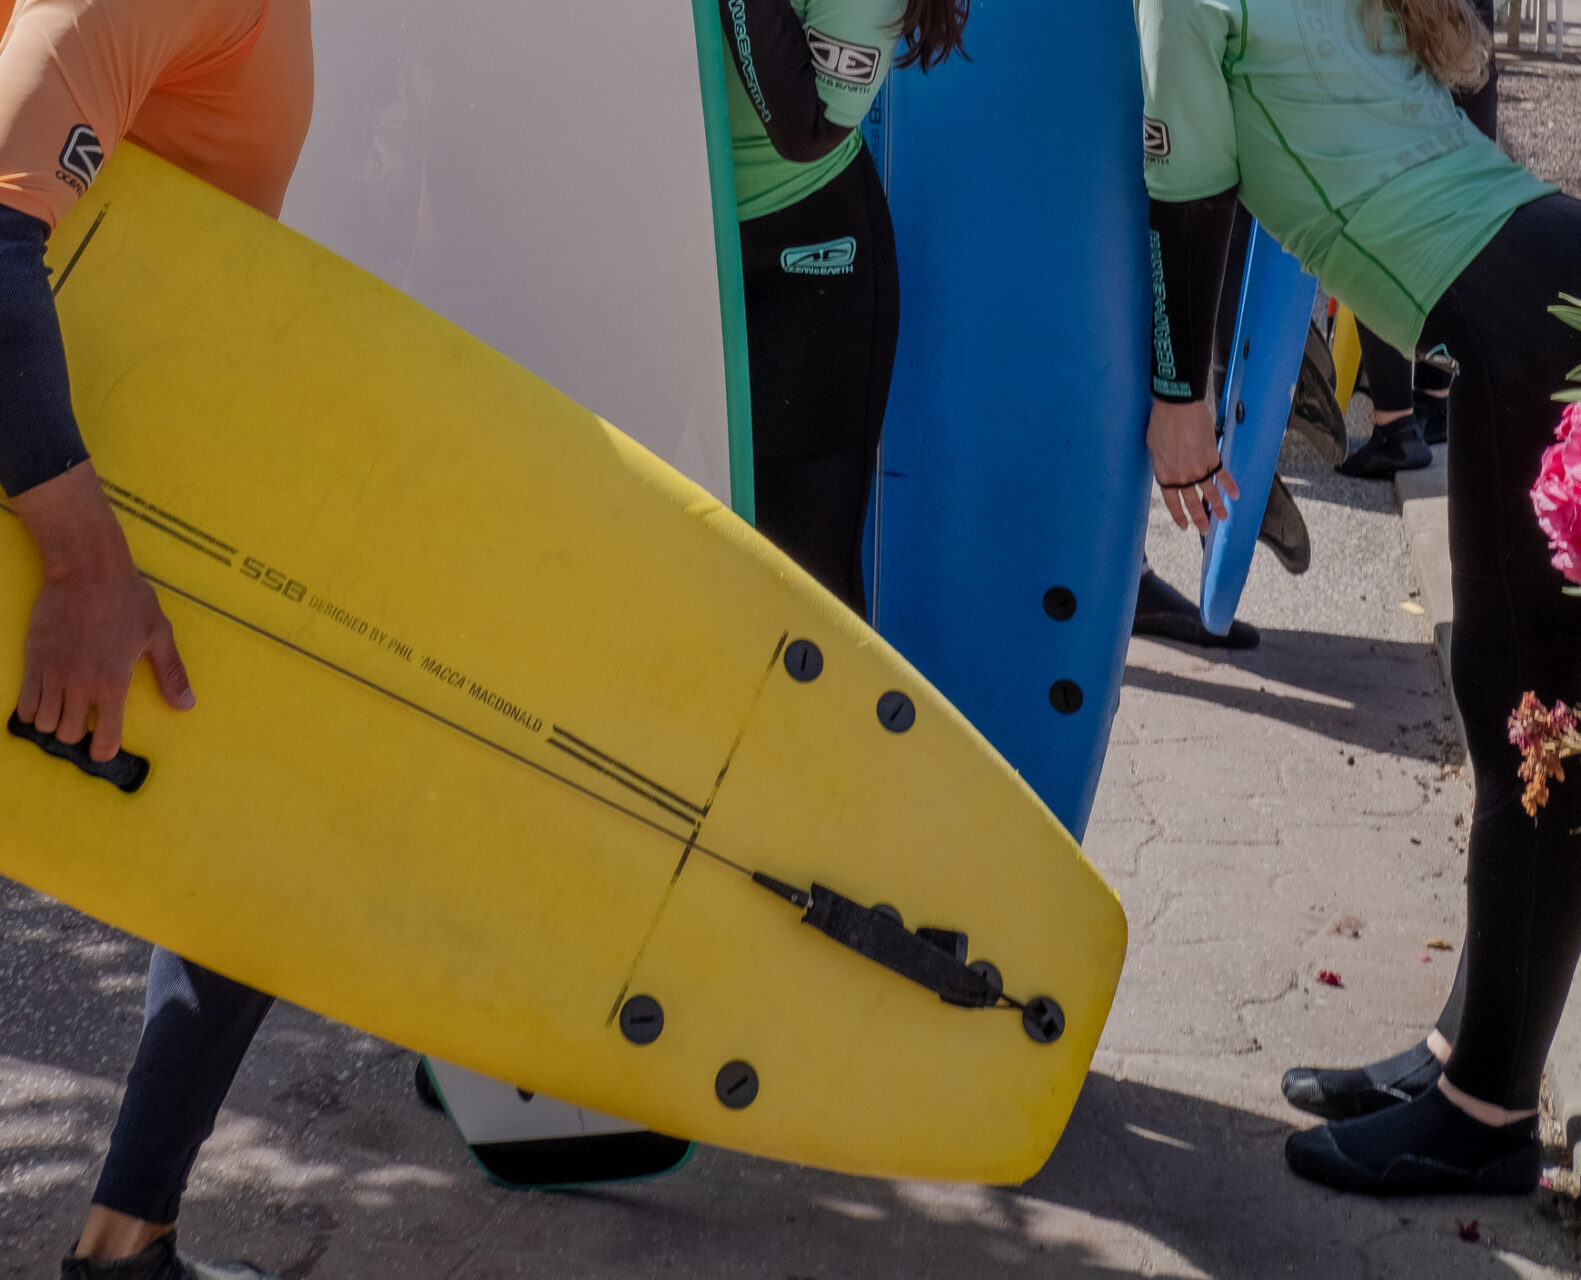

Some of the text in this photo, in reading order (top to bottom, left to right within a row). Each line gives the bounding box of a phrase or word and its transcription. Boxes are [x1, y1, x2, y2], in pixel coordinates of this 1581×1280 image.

[240, 556, 308, 604] SSB
[308, 594, 369, 636] DESIGNED
[369, 627, 388, 646] BY
[387, 638, 413, 663] PHIL
[468, 682, 543, 734] MACDONALD
